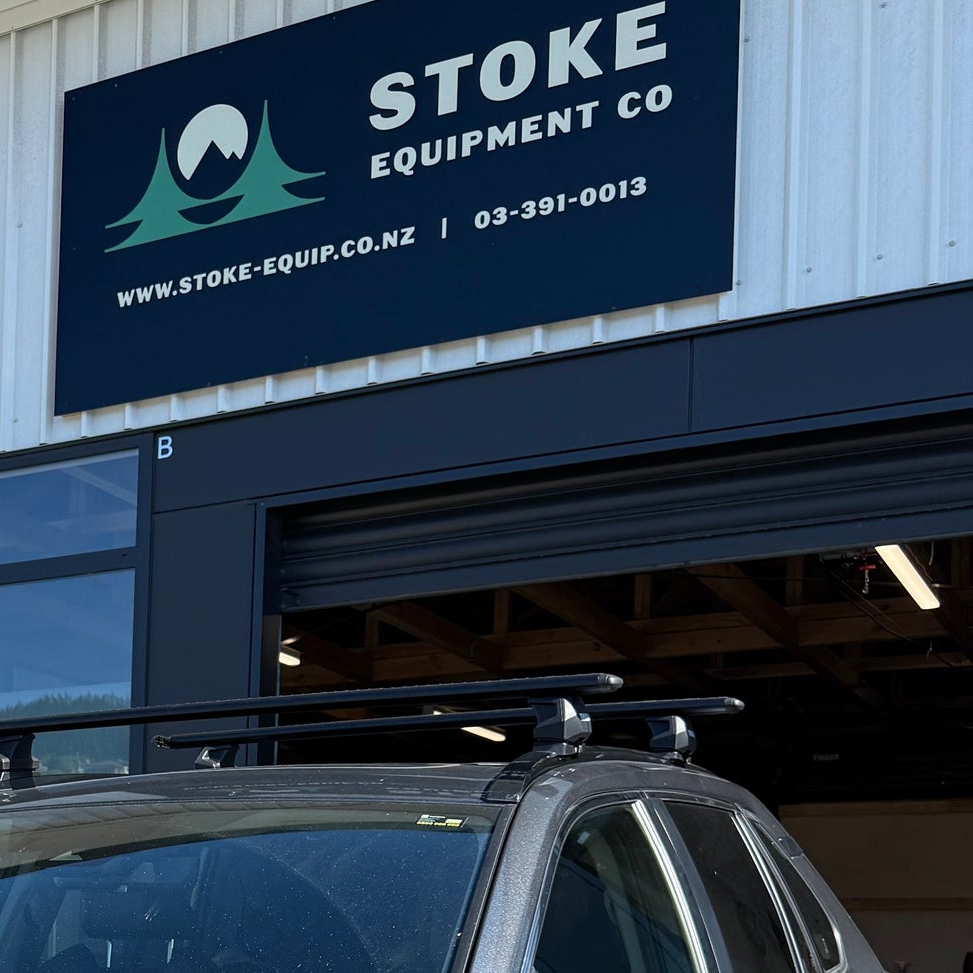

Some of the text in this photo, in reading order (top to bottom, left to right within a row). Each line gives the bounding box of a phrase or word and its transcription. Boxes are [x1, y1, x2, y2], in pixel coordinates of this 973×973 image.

[369, 1, 667, 131] STOKE
[370, 84, 673, 179] EQUIPMENT CO
[116, 226, 416, 309] WWW.STOKE-EQUIP.CO.NZ
[473, 176, 648, 230] 03-391-0013
[157, 436, 173, 460] B
